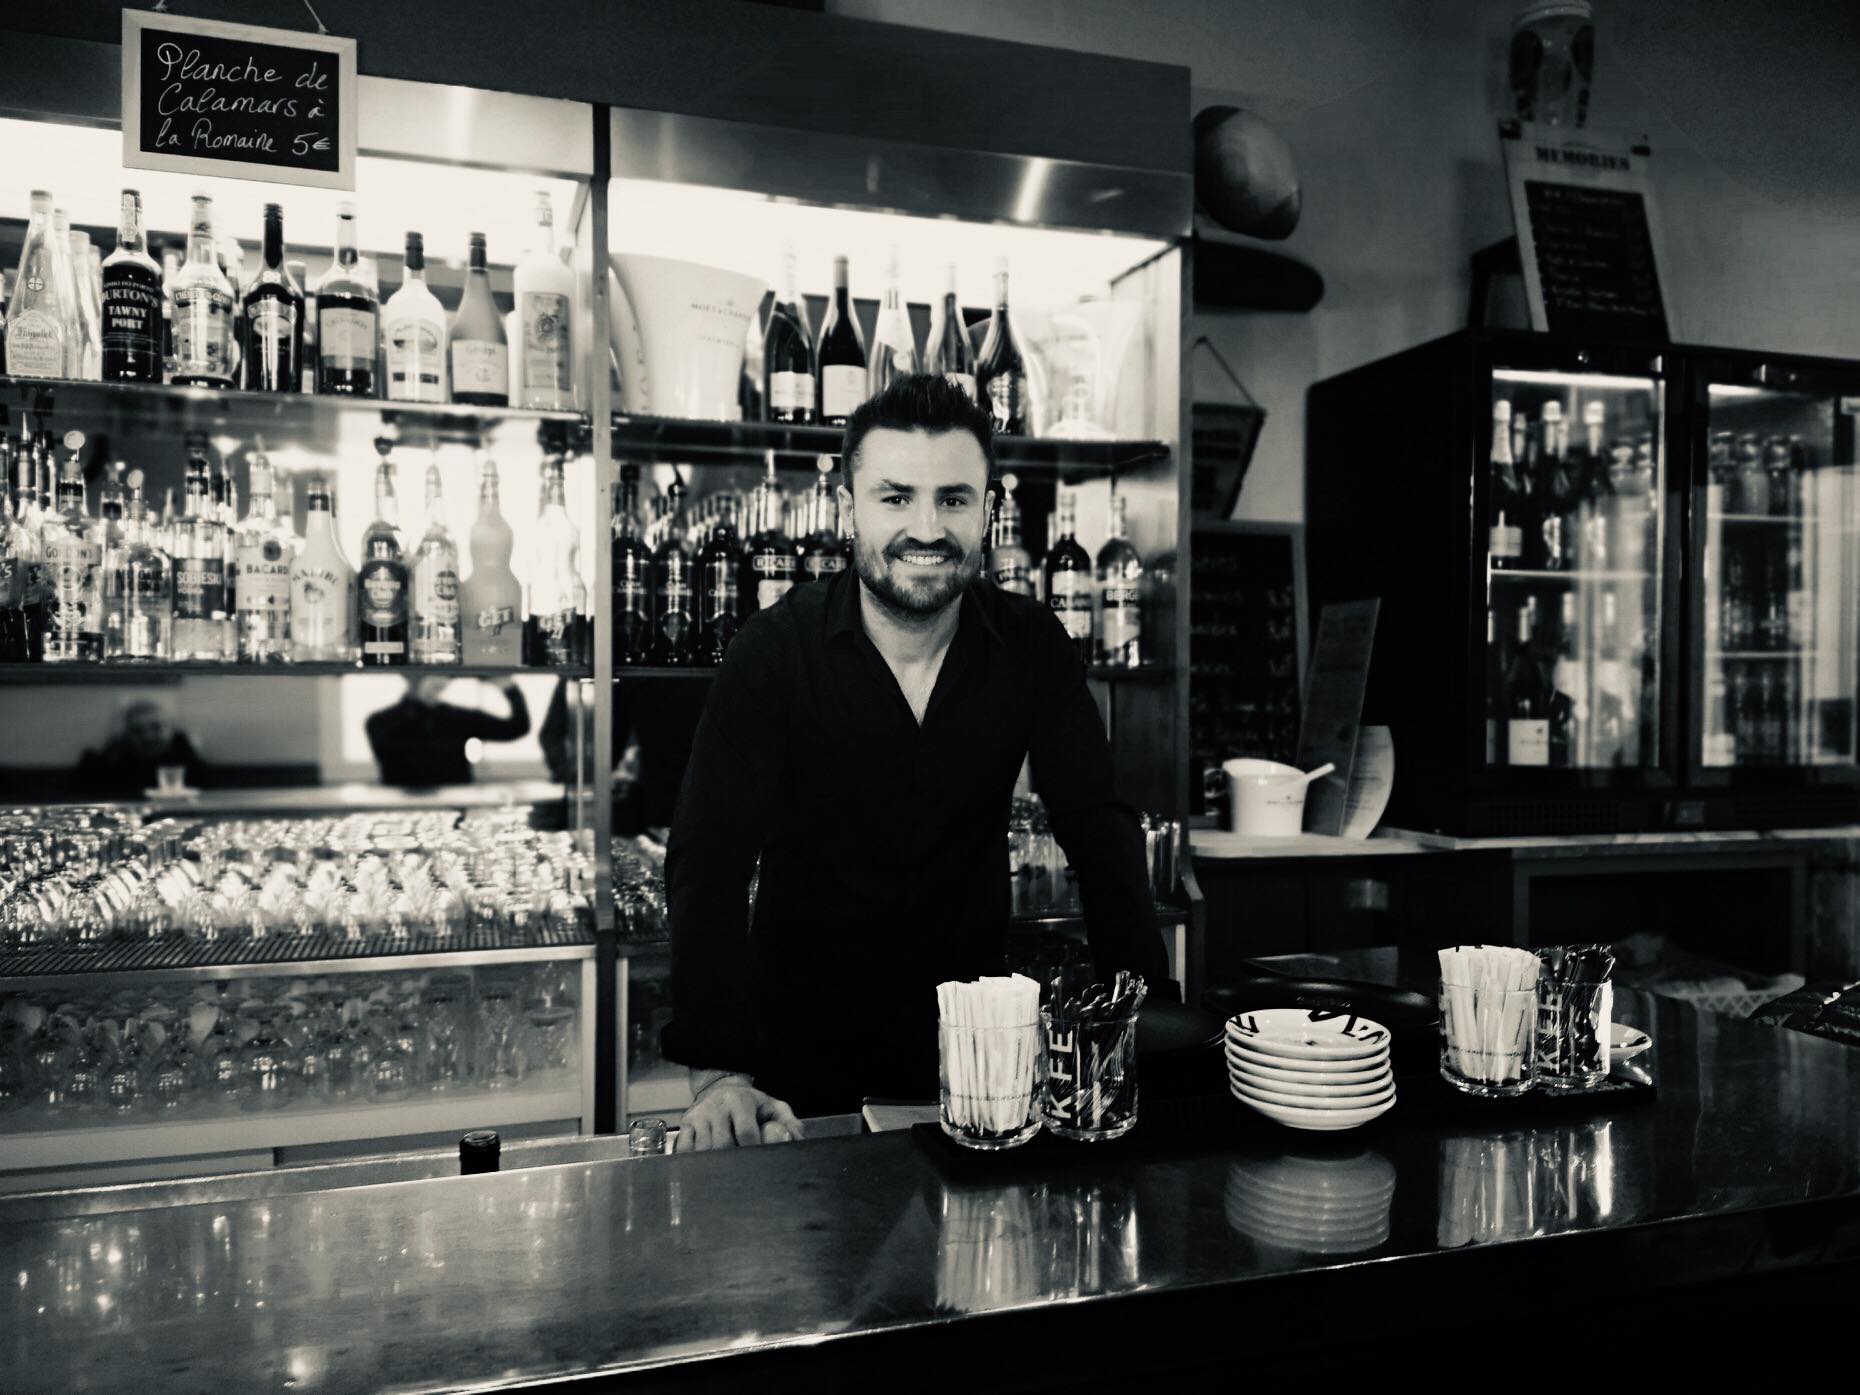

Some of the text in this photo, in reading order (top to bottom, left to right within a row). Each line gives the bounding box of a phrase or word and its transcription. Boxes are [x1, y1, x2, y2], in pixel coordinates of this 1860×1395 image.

[157, 42, 329, 90] Planche de
[158, 82, 326, 119] Calamars à
[155, 117, 332, 156] la Romaine 5€
[108, 305, 148, 318] TAWNY
[112, 317, 144, 330] PORT
[246, 563, 289, 575] BACARD
[756, 558, 796, 567] RCARD
